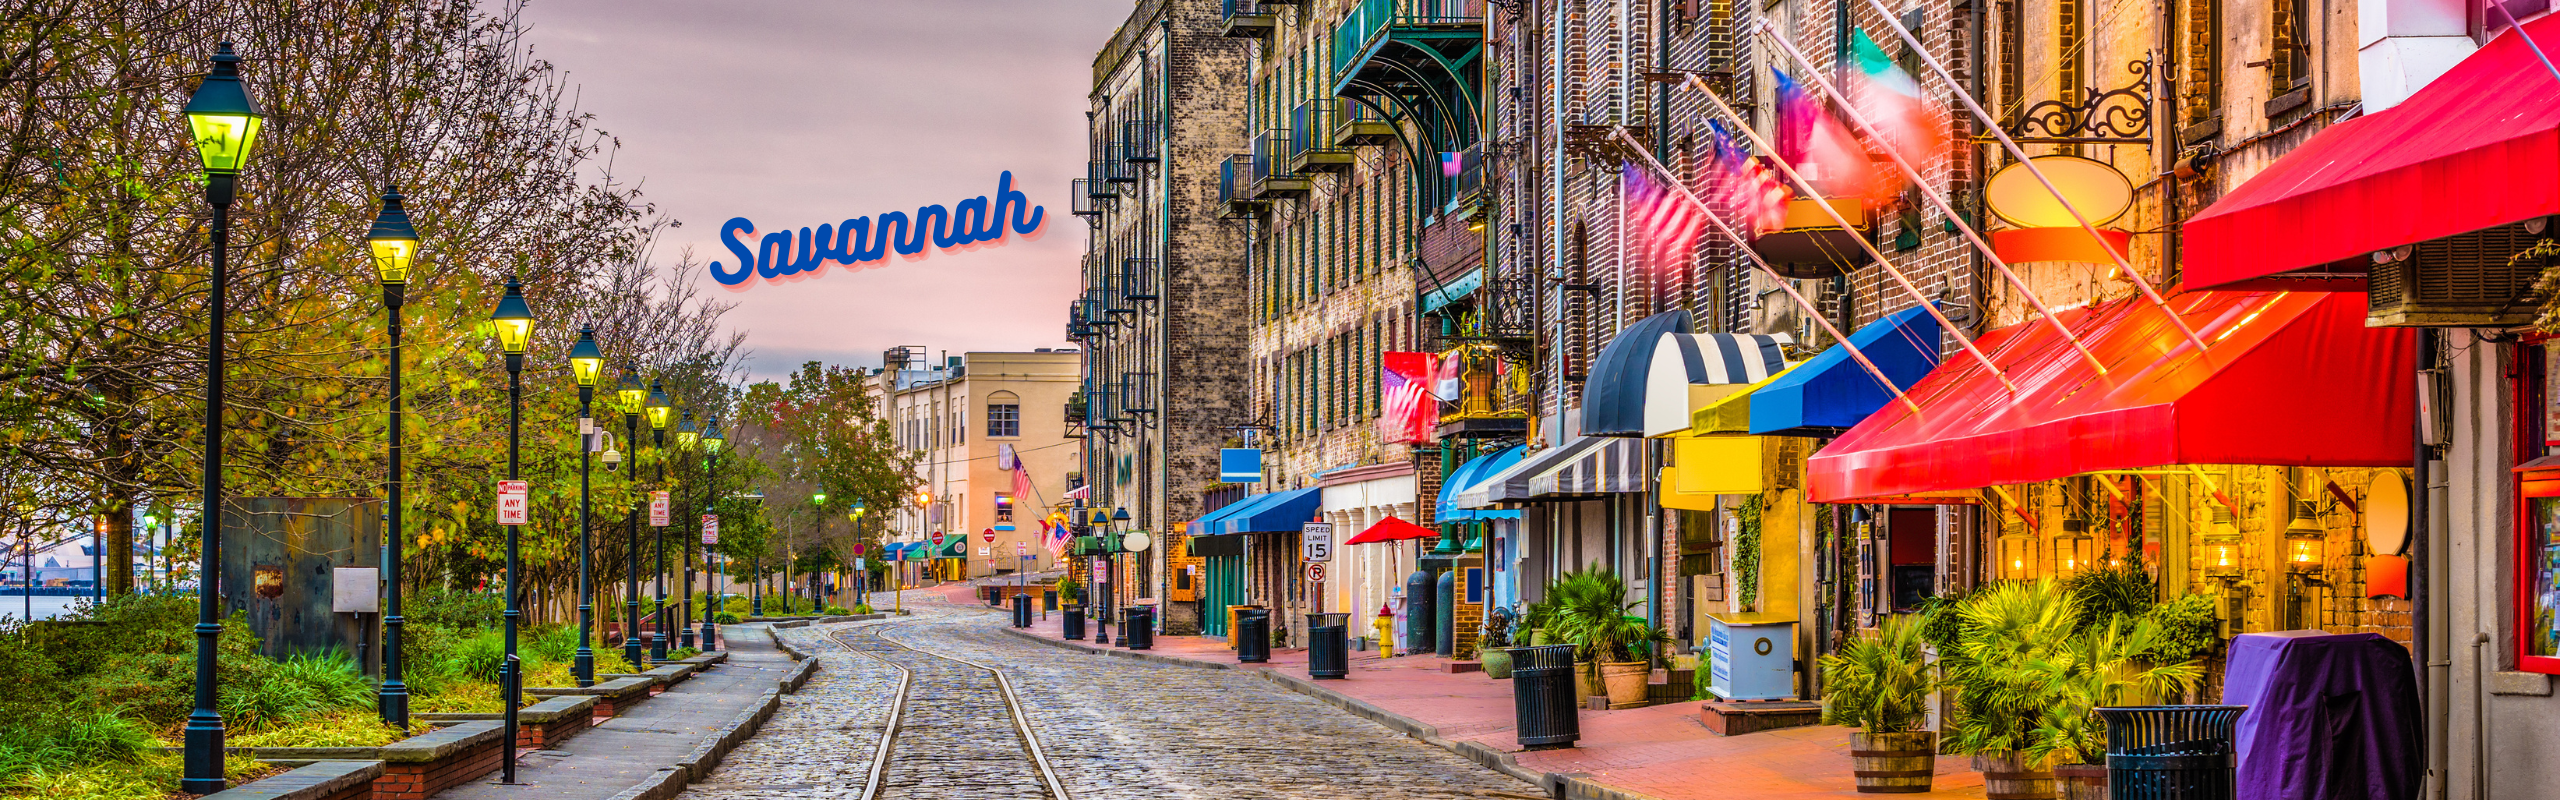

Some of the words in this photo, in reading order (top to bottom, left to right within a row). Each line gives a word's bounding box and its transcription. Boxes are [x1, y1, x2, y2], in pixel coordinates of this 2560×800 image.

[499, 484, 507, 493] NO
[504, 499, 521, 508] ANY
[503, 510, 522, 518] TIME
[1308, 543, 1326, 558] 15
